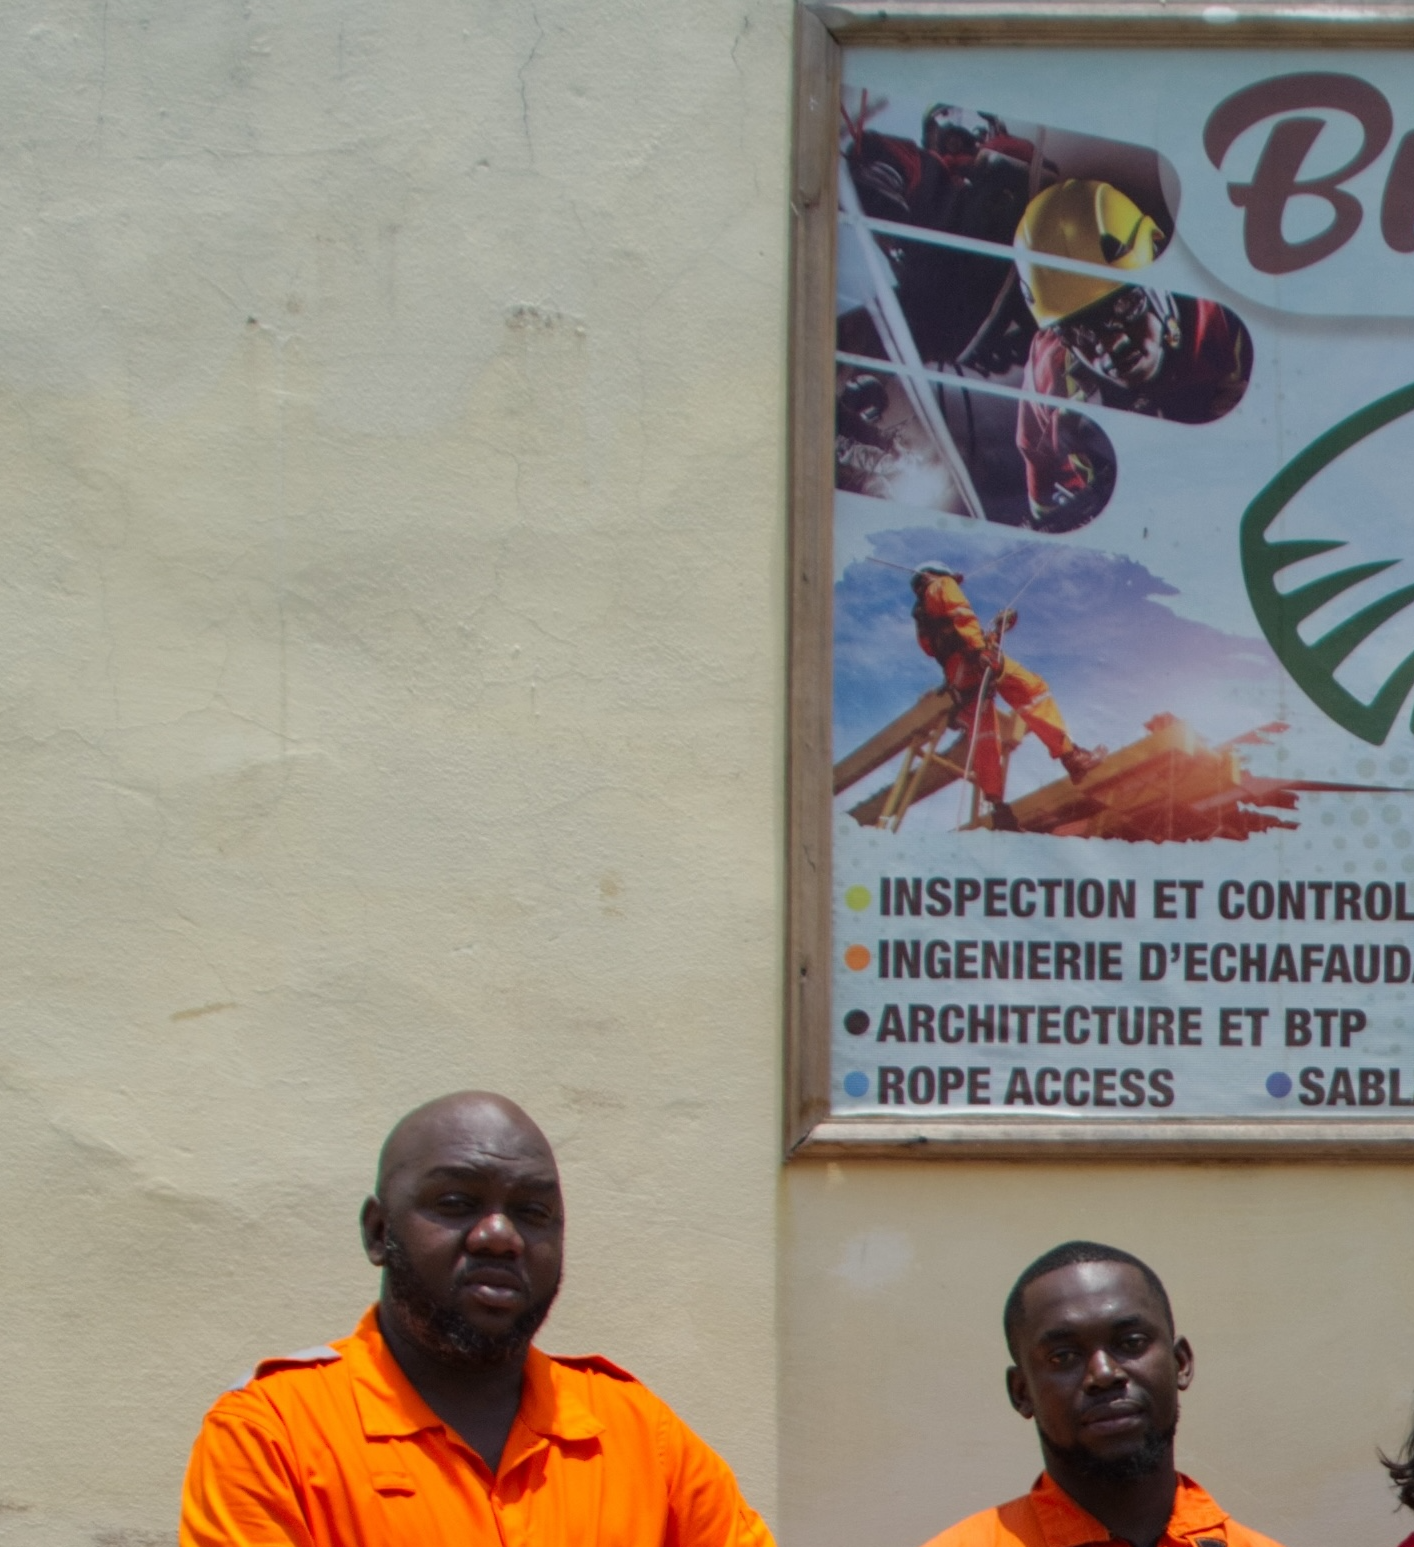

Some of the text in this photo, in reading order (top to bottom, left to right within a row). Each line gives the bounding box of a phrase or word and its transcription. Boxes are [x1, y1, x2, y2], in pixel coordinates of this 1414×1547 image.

[879, 875, 1137, 920] INSPECTION
[1152, 878, 1205, 921] ET
[877, 938, 1124, 982] INGENIERIE
[875, 1002, 1368, 1049] ARCHITECTURE ET BTP
[876, 1065, 1176, 1109] ROPE ACCESS
